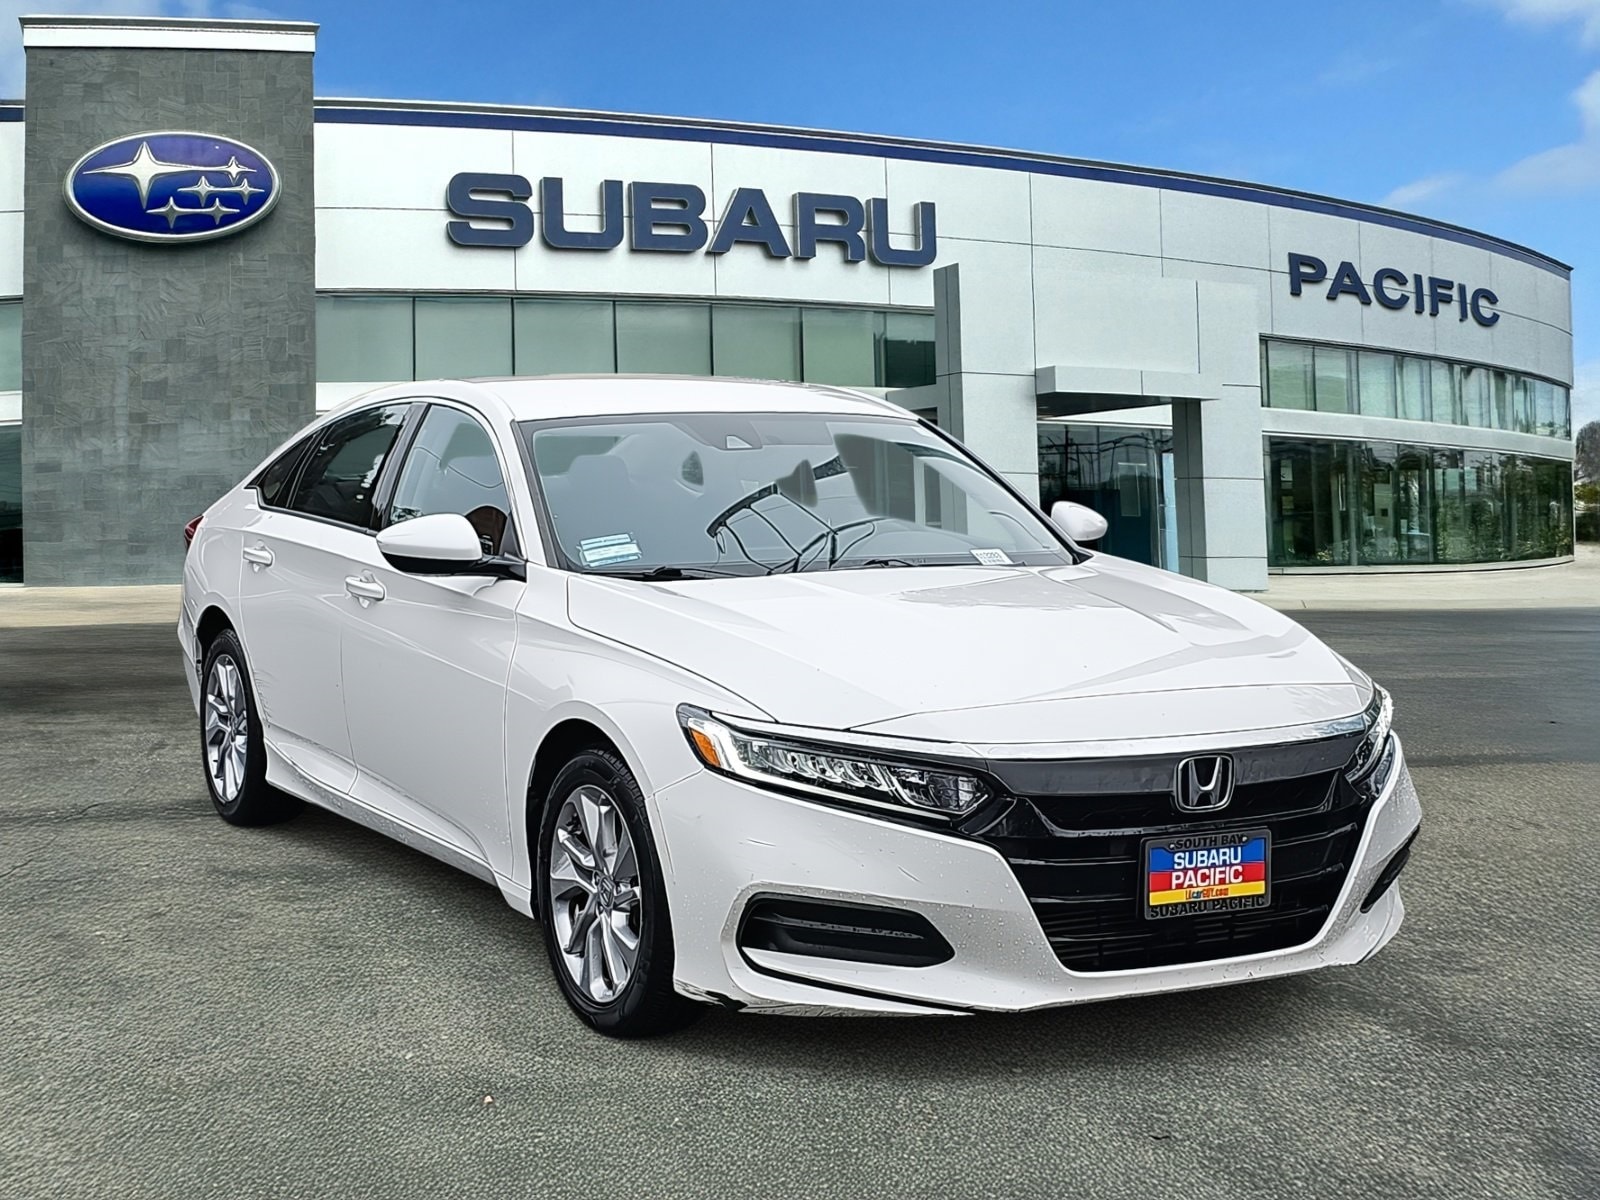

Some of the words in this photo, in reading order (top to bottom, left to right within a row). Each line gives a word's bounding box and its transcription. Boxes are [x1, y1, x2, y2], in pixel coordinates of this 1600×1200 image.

[446, 171, 937, 267] SUBARU
[1288, 252, 1500, 327] PACIFIC
[1175, 836, 1217, 849] SOUTH
[1221, 833, 1244, 846] BAY
[1173, 846, 1242, 869] SUBARU
[1171, 865, 1243, 889] PACIFIC
[1150, 901, 1207, 918] SUBARU
[1212, 895, 1265, 911] PACIFIC
